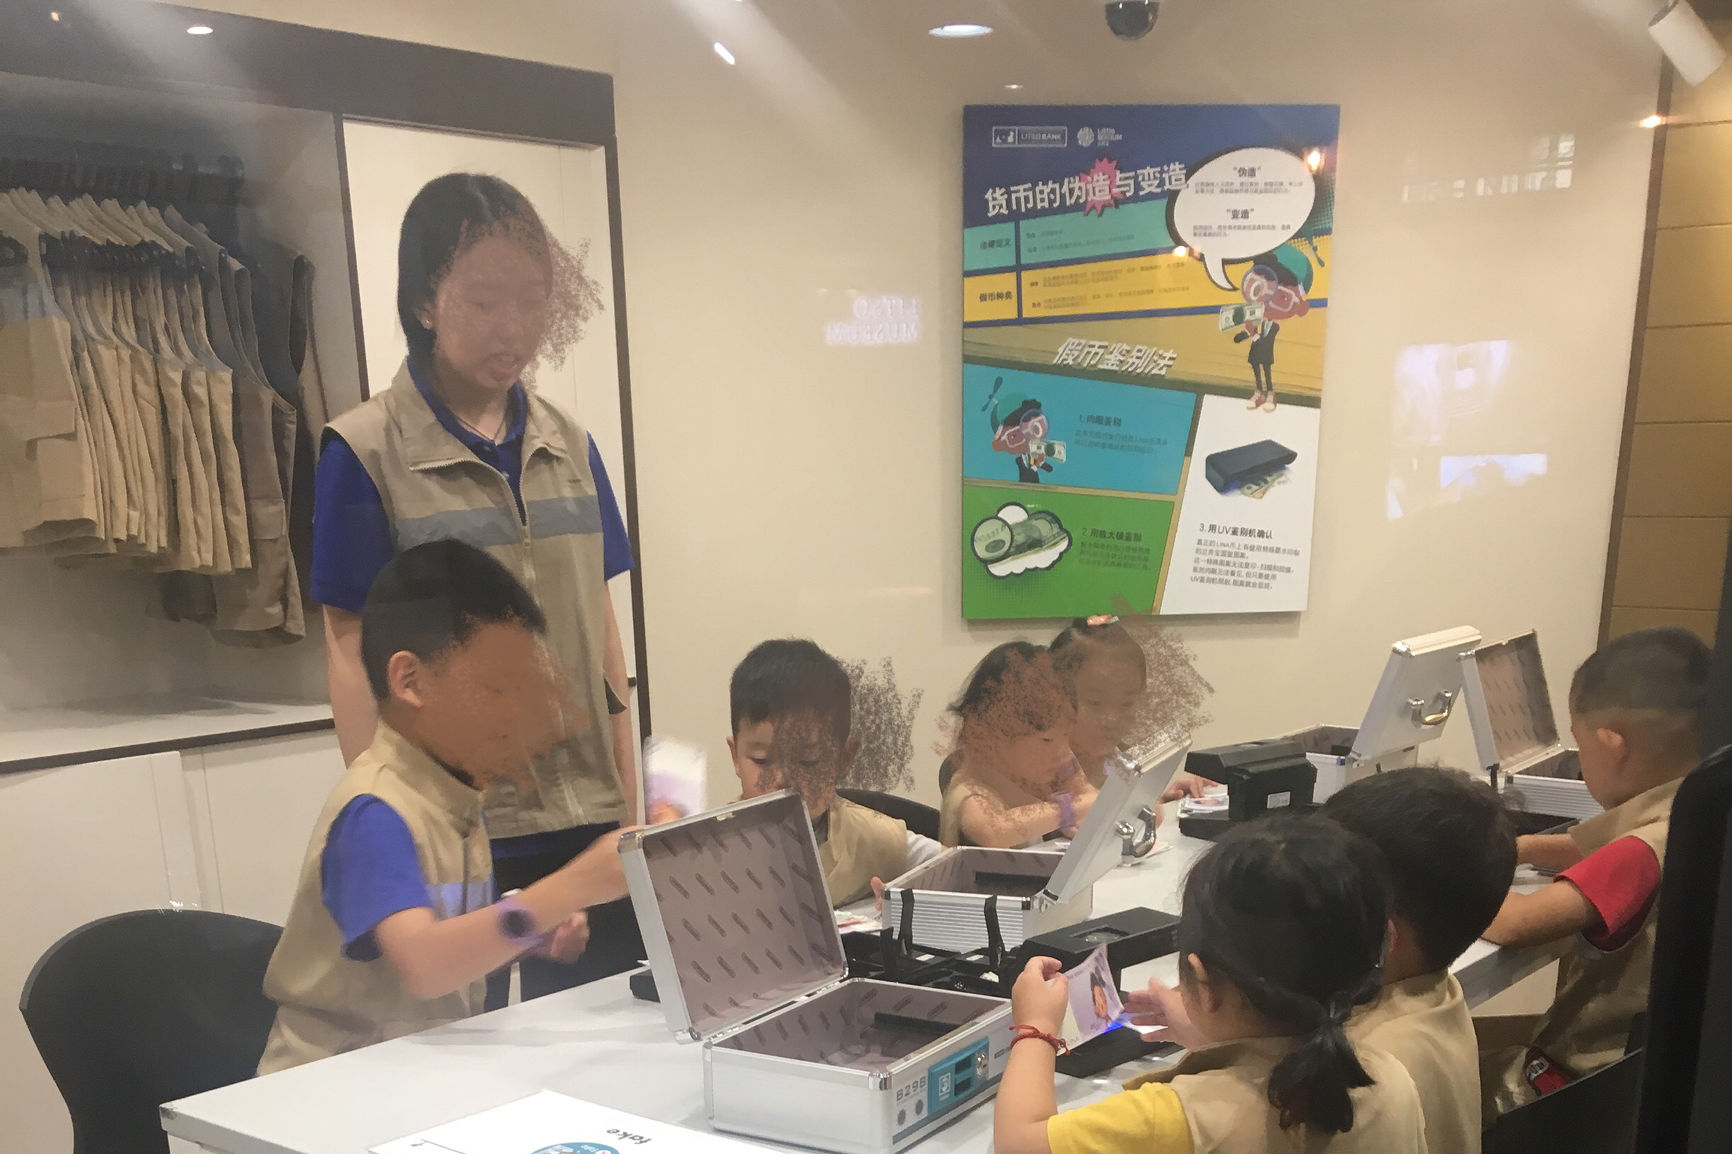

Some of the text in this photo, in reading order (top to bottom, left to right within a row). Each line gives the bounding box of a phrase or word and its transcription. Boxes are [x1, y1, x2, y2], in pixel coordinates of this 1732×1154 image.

[985, 162, 1190, 217] 货币的伪造与变造
[979, 290, 1013, 303] 假币种类
[1052, 336, 1178, 377] 假币鉴别法
[605, 1128, 653, 1145] fake
